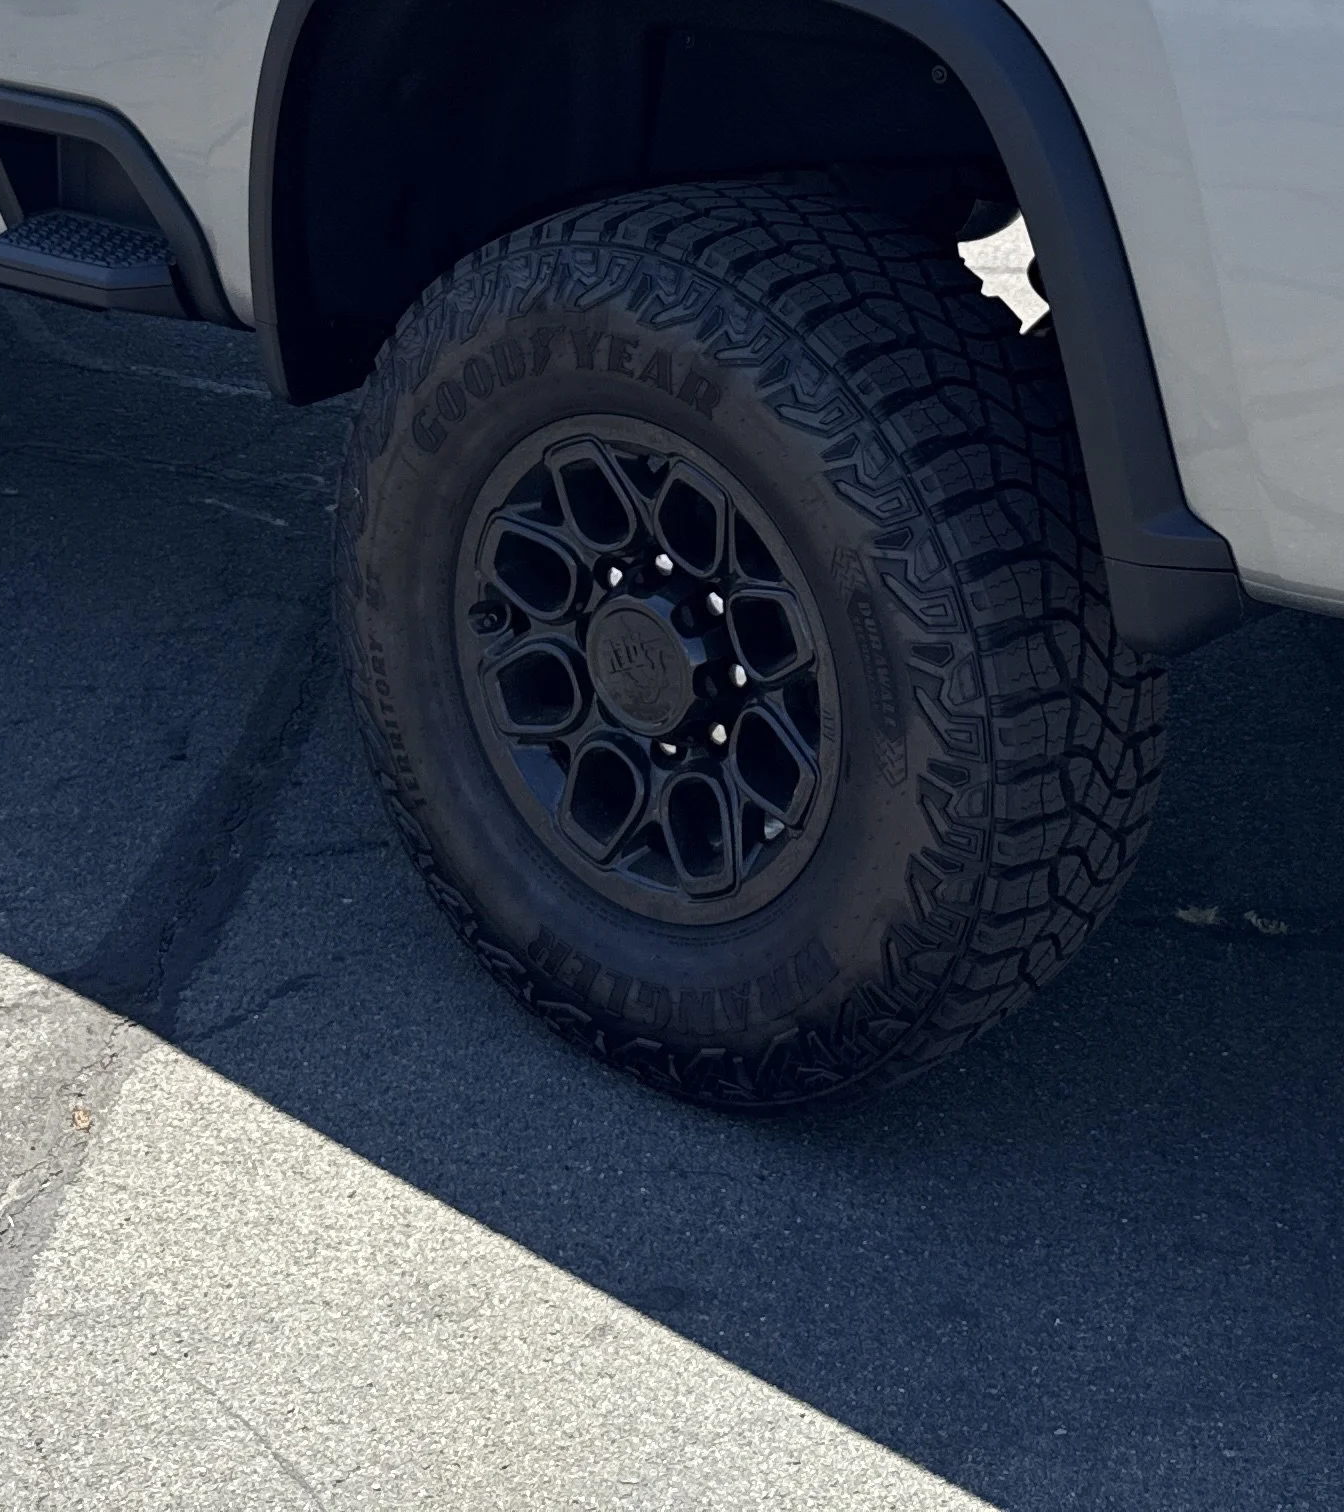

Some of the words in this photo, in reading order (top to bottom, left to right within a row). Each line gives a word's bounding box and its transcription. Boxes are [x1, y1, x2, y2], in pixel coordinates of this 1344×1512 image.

[411, 325, 722, 453] GOODYEAR
[368, 632, 428, 808] TERRITORY
[526, 924, 842, 1038] WRANGLER
